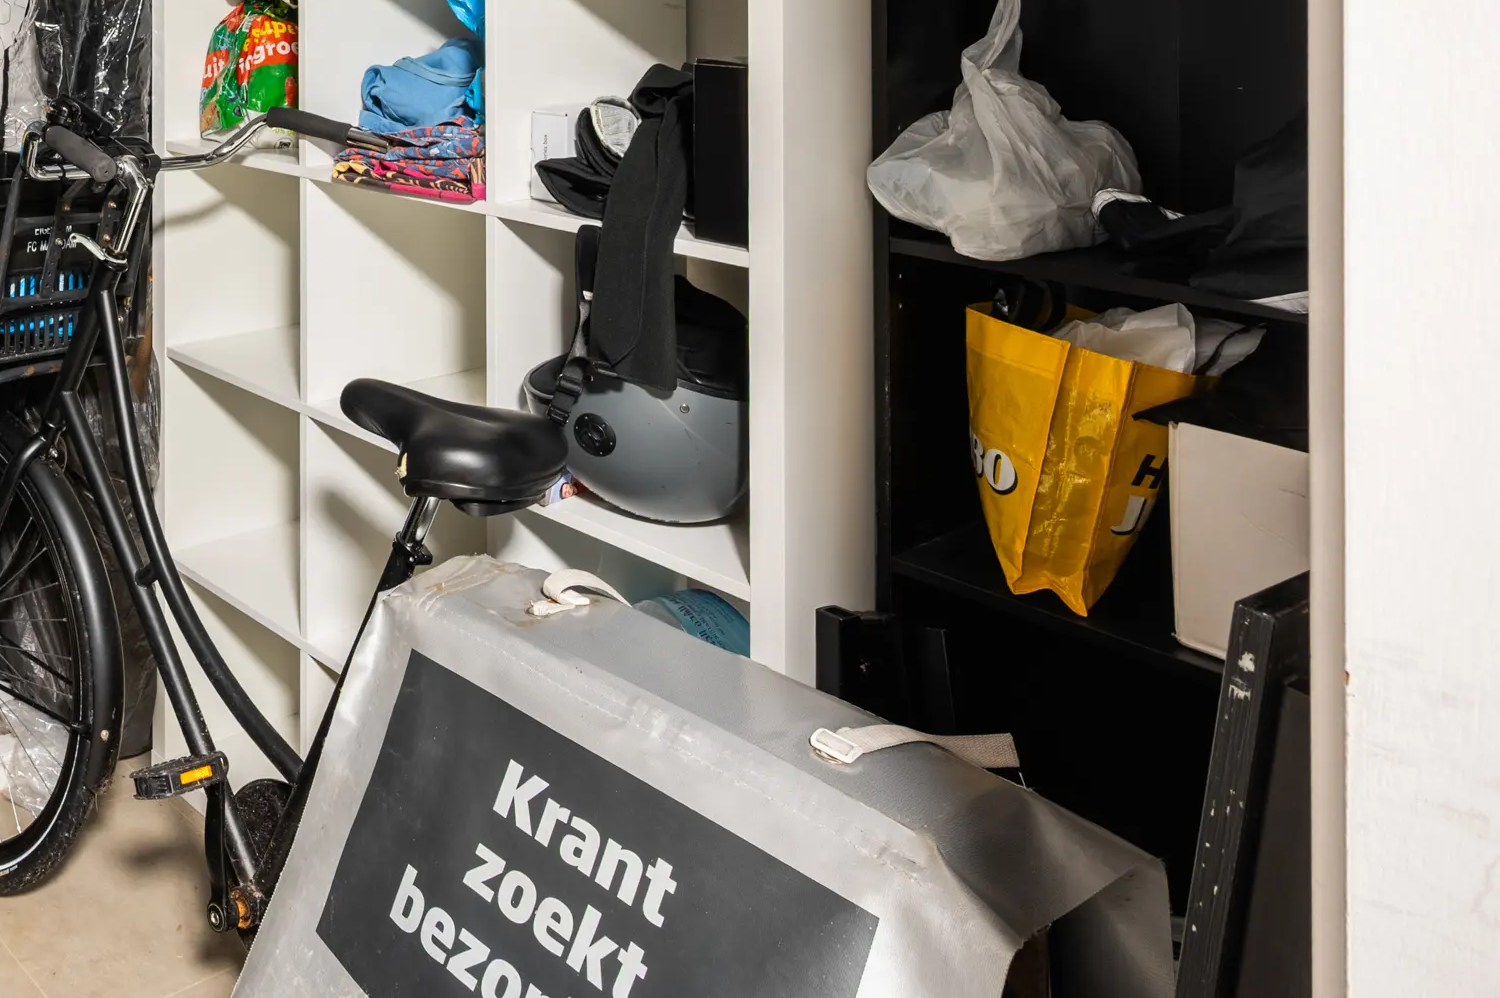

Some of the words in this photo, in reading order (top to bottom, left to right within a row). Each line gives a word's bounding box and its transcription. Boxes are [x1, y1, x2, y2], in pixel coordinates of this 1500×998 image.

[26, 241, 38, 253] FC
[462, 842, 649, 998] zoekt
[492, 758, 678, 928] Krant
